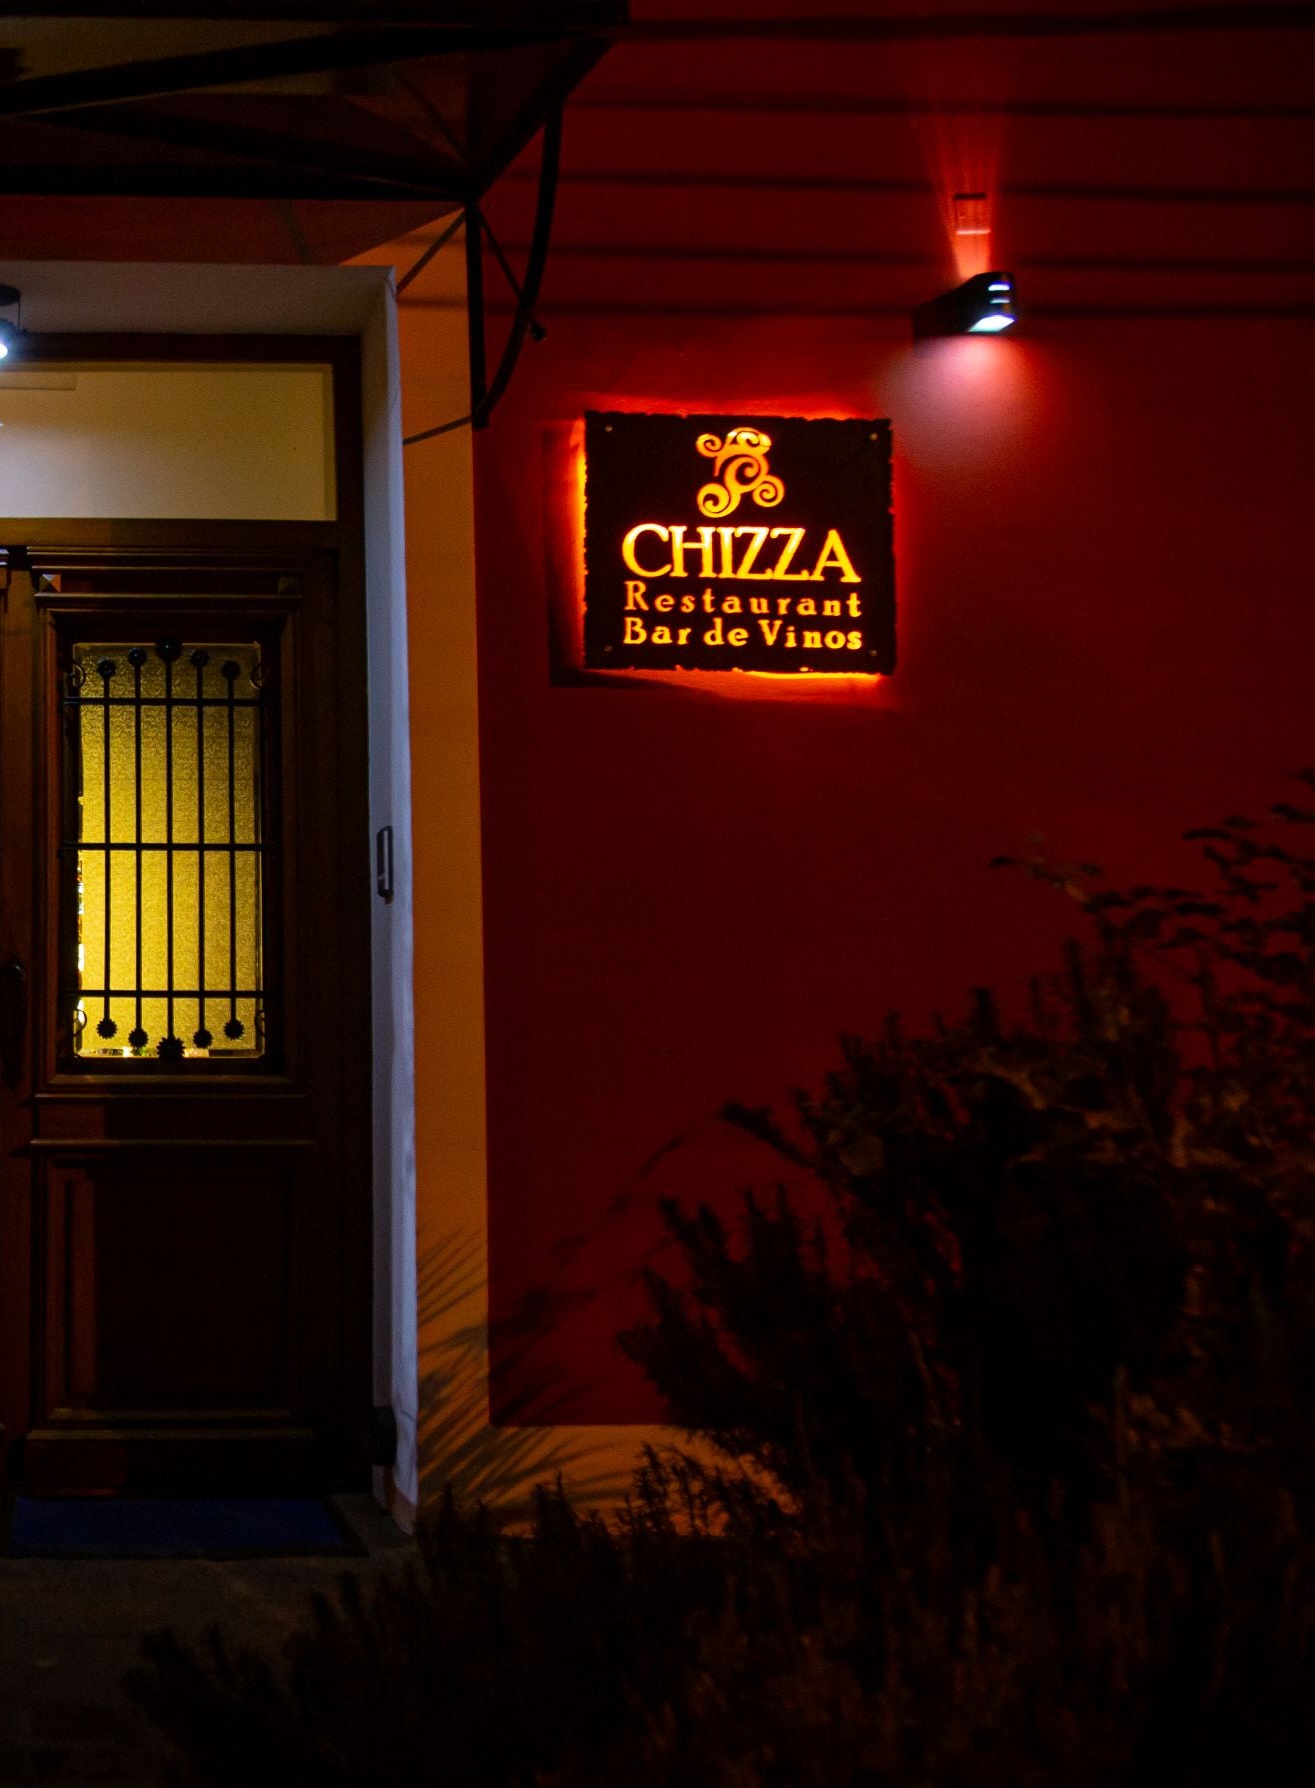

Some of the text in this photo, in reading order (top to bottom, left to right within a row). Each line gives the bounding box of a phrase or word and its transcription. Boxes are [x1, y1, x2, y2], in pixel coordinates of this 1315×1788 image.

[621, 523, 862, 583] CHIZZA
[623, 580, 863, 618] Restaurant
[622, 616, 863, 650] Bar de Vinos
